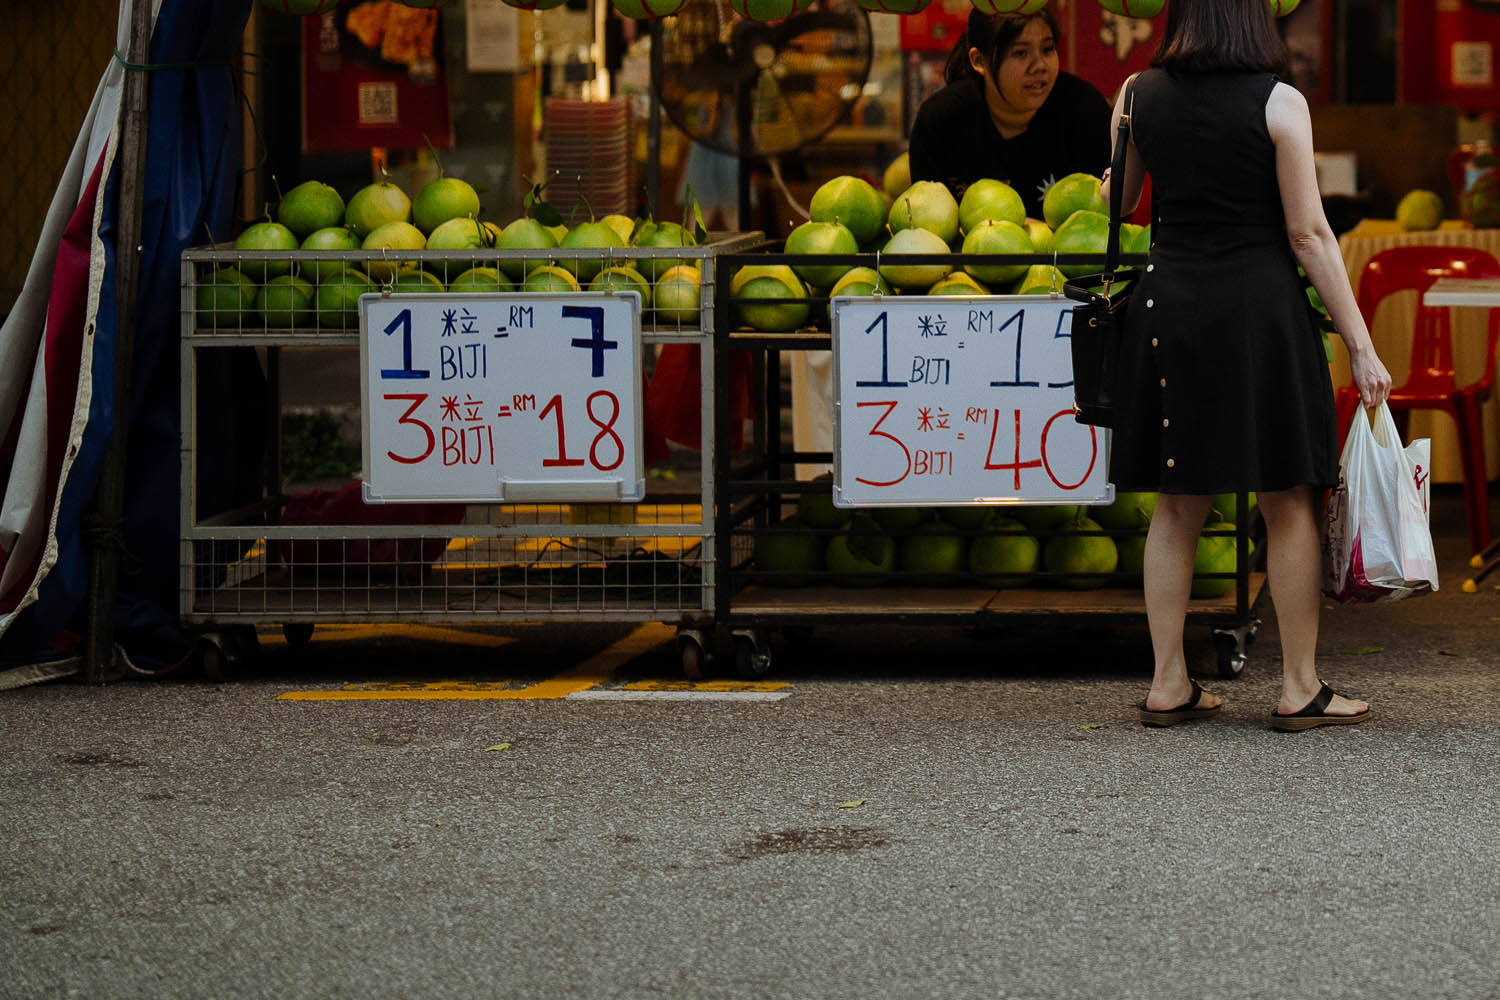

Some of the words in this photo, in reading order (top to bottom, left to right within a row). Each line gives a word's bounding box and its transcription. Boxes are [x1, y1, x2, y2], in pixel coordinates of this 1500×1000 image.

[440, 307, 480, 337] 粒
[508, 304, 534, 329] RM
[917, 314, 948, 339] 粒
[967, 309, 994, 334] RM
[380, 308, 431, 380] 1
[561, 304, 619, 378] 7
[855, 310, 909, 388] 1
[439, 343, 488, 381] BIJI
[908, 355, 951, 385] BIJI
[439, 393, 484, 423] 粒
[512, 393, 536, 412] RM
[964, 406, 988, 426] RM
[382, 393, 436, 465] 3
[538, 389, 626, 472] 18
[916, 406, 951, 433] 粒
[441, 424, 495, 467] BIJI
[855, 400, 912, 487] 3
[983, 407, 1099, 491] 40
[913, 449, 954, 477] BIJI
